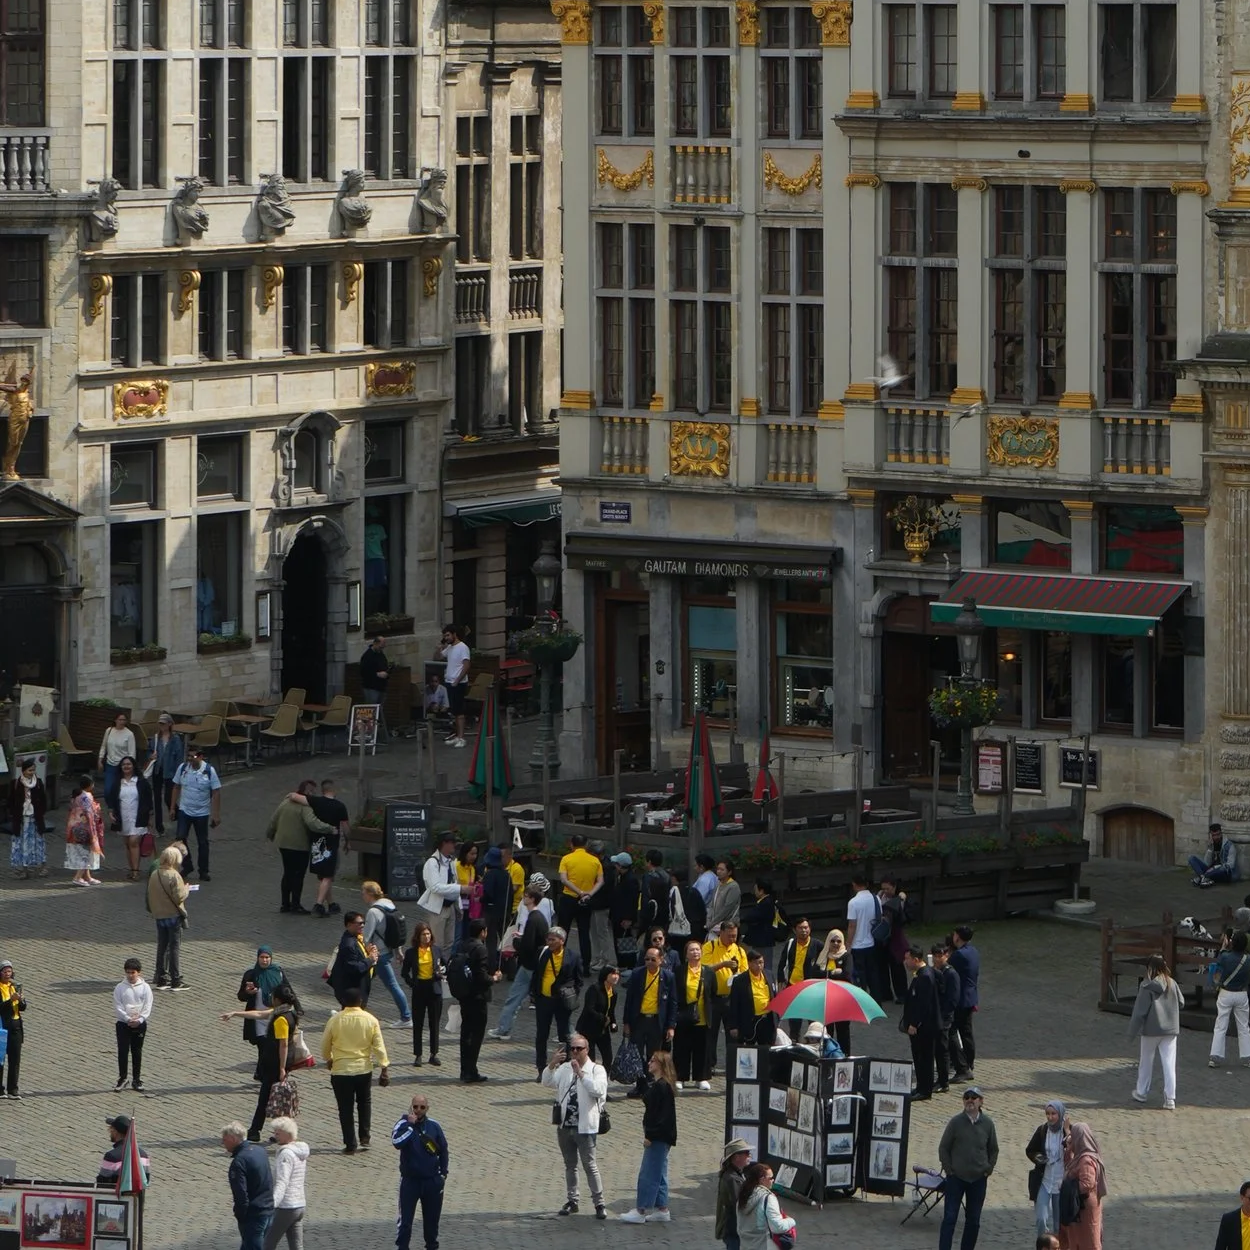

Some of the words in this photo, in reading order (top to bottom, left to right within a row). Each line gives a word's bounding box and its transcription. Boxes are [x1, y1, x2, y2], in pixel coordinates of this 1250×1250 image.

[644, 559, 687, 574] GAUTAM
[695, 562, 750, 578] DIAMONDS
[773, 568, 801, 577] JEWELLERS
